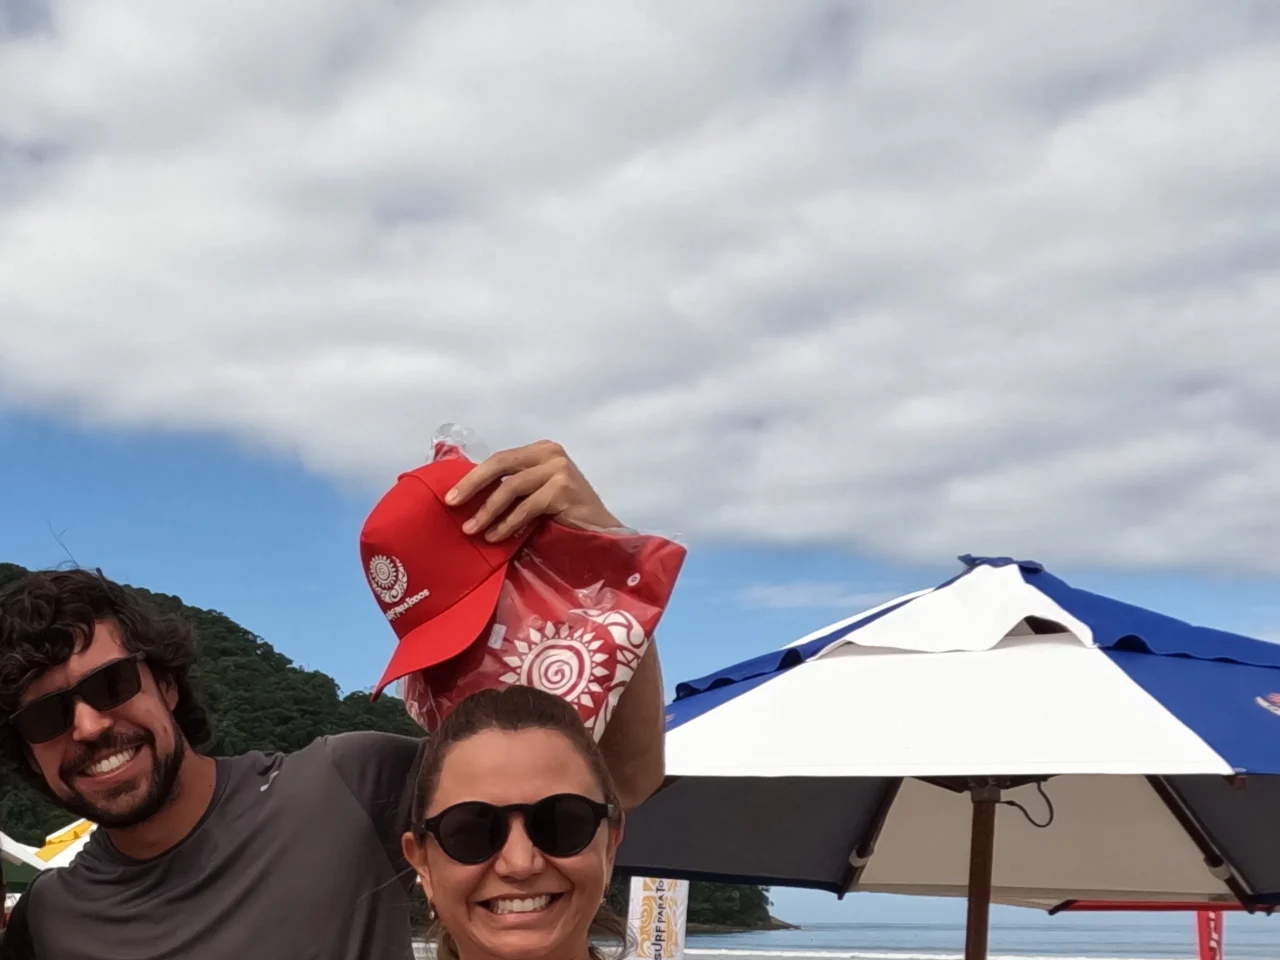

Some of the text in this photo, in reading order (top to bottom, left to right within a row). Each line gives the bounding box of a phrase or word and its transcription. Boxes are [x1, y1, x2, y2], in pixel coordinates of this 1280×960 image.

[405, 588, 430, 607] TODOS
[657, 894, 666, 923] PARA
[651, 926, 666, 960] SURF
